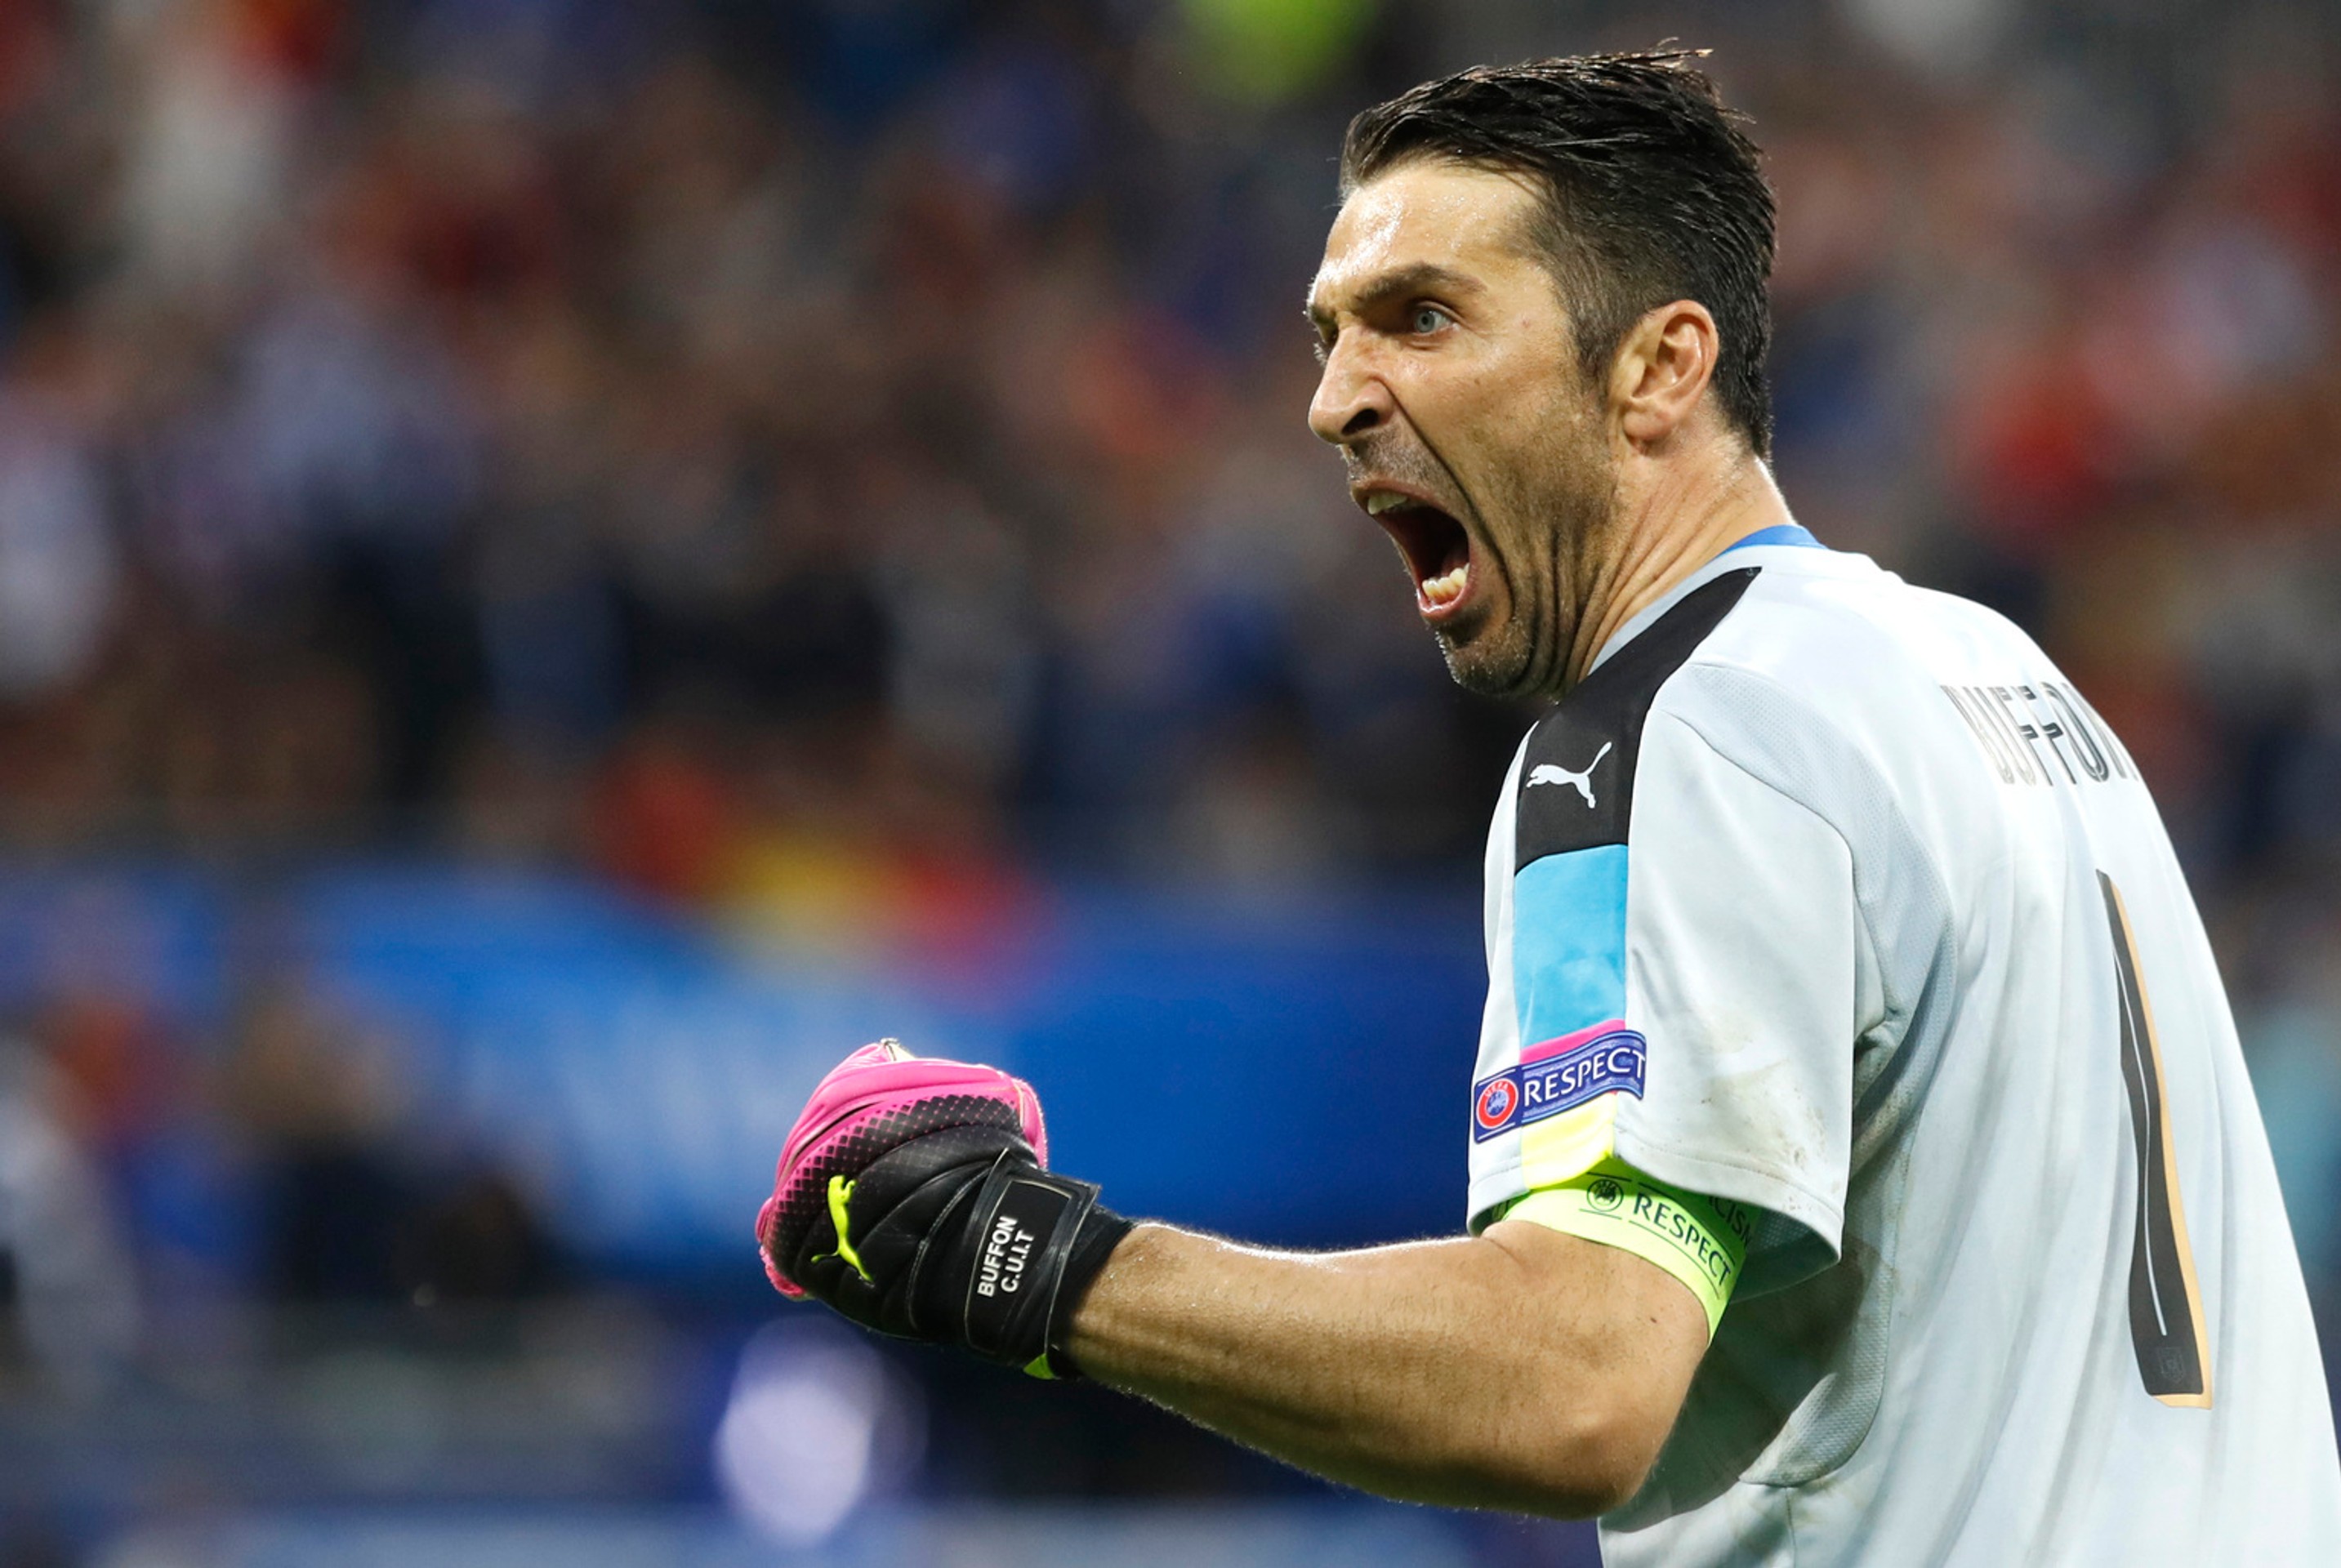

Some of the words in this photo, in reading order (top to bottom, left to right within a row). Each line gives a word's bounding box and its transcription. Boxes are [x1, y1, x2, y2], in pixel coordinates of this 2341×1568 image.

[1524, 1046, 1645, 1107] RESPECT
[2096, 868, 2213, 1410] 1
[978, 1215, 1018, 1297] BUFFON
[1001, 1229, 1034, 1293] C.U.I.T
[1634, 1192, 1731, 1285] RESPECT
